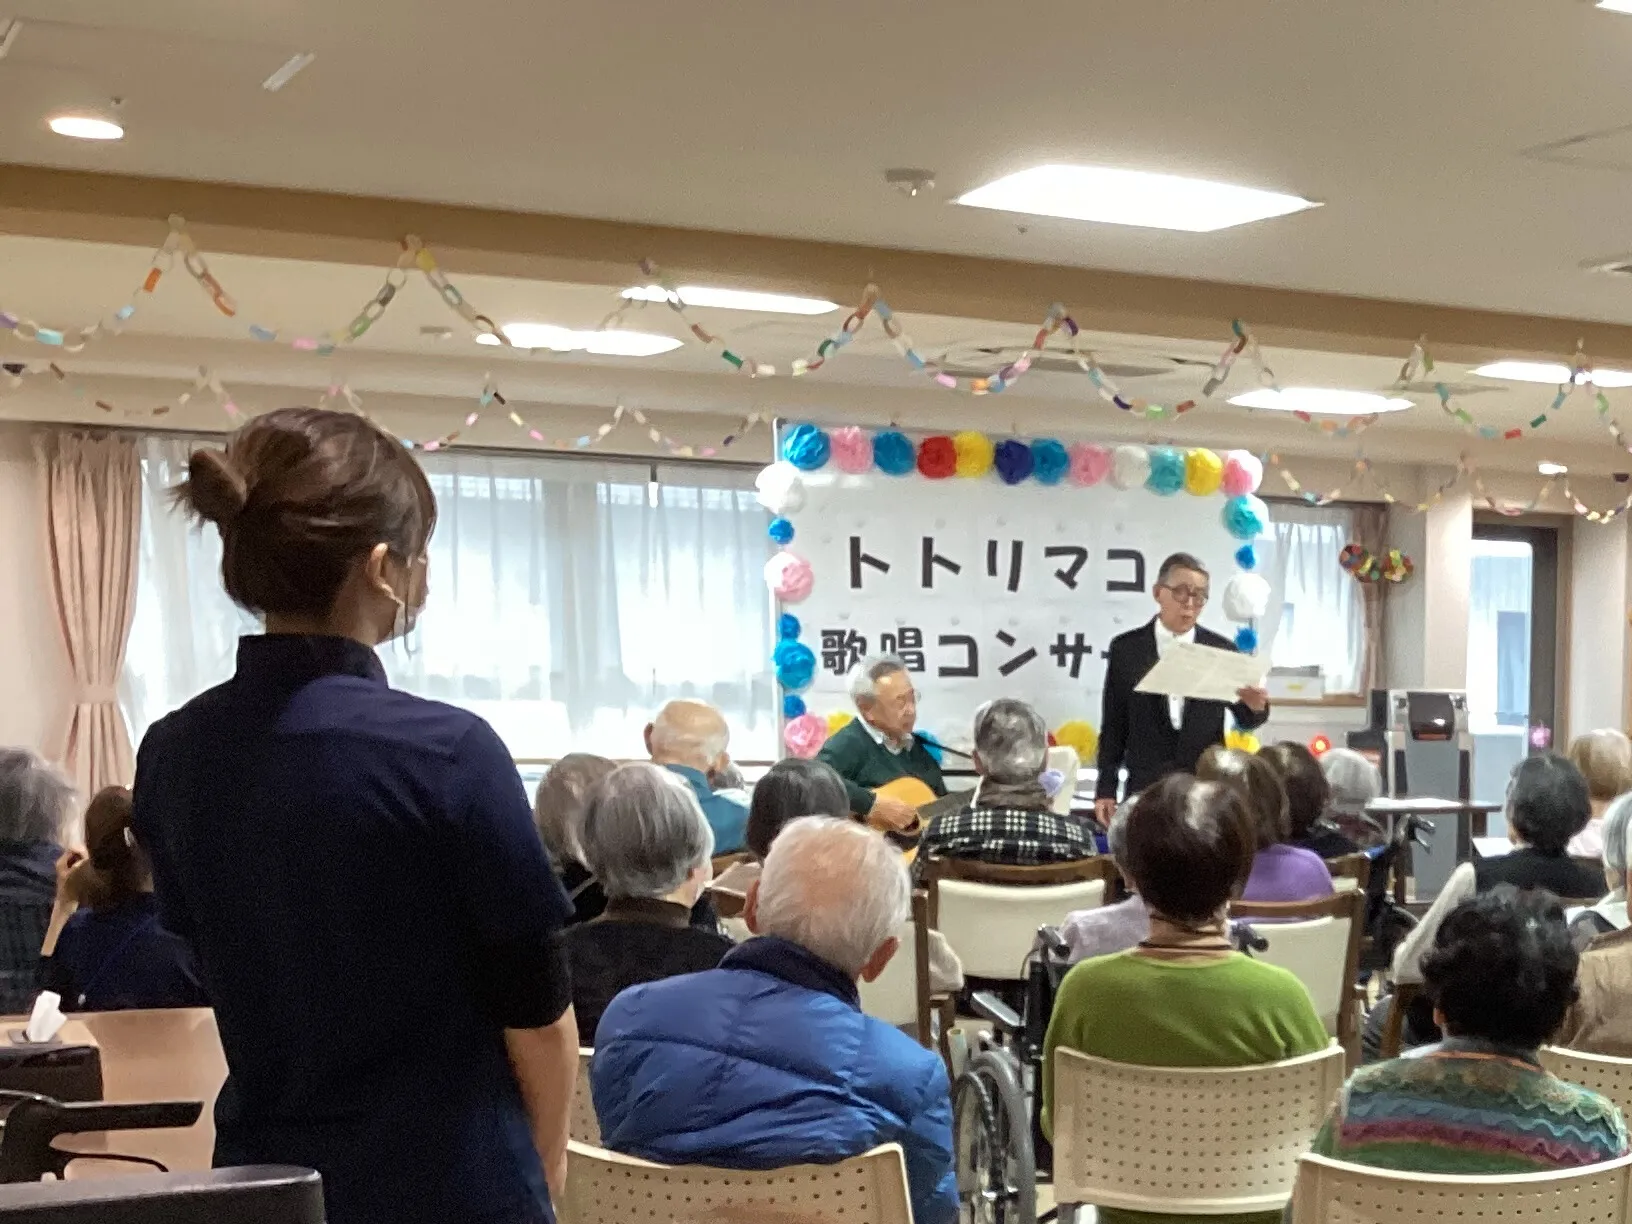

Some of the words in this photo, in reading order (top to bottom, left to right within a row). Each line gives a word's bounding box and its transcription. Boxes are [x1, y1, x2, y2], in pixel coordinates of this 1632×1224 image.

[820, 626, 1112, 679] 歌唱コンサ
